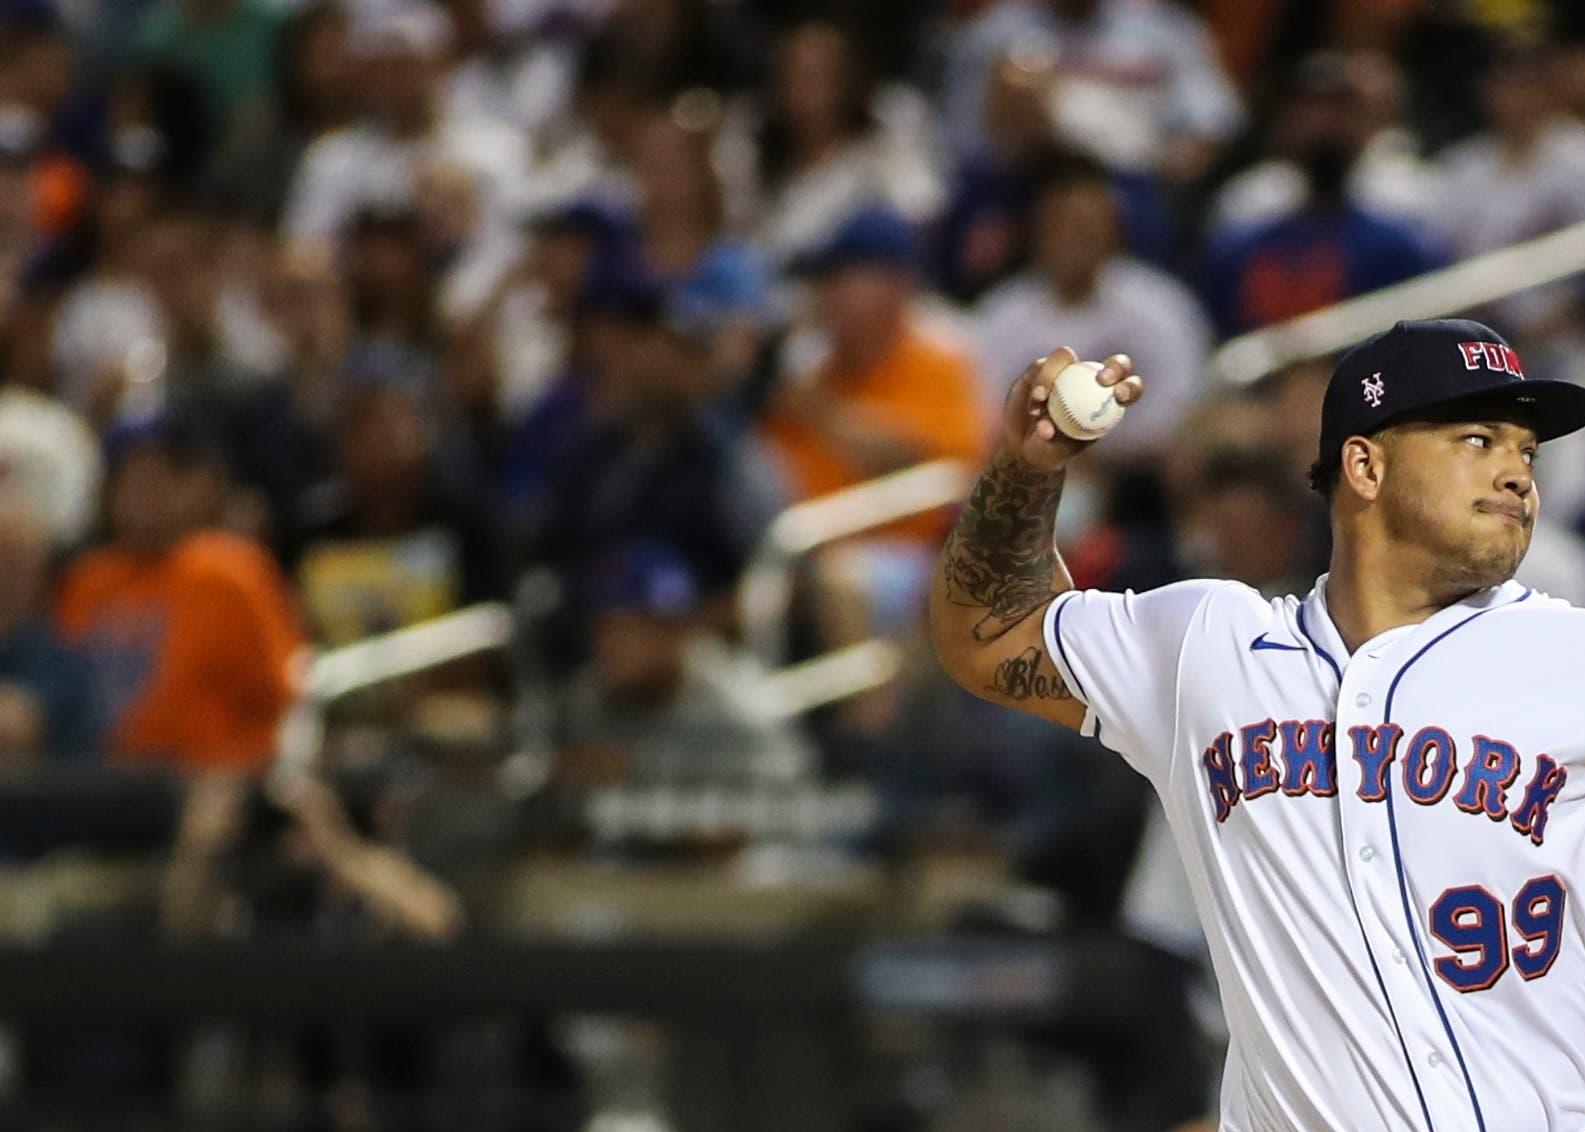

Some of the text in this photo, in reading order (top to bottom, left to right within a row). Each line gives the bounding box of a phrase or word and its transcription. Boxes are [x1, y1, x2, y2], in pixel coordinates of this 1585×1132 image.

[1203, 717, 1568, 847] NEW YORK
[1429, 874, 1567, 994] 99
